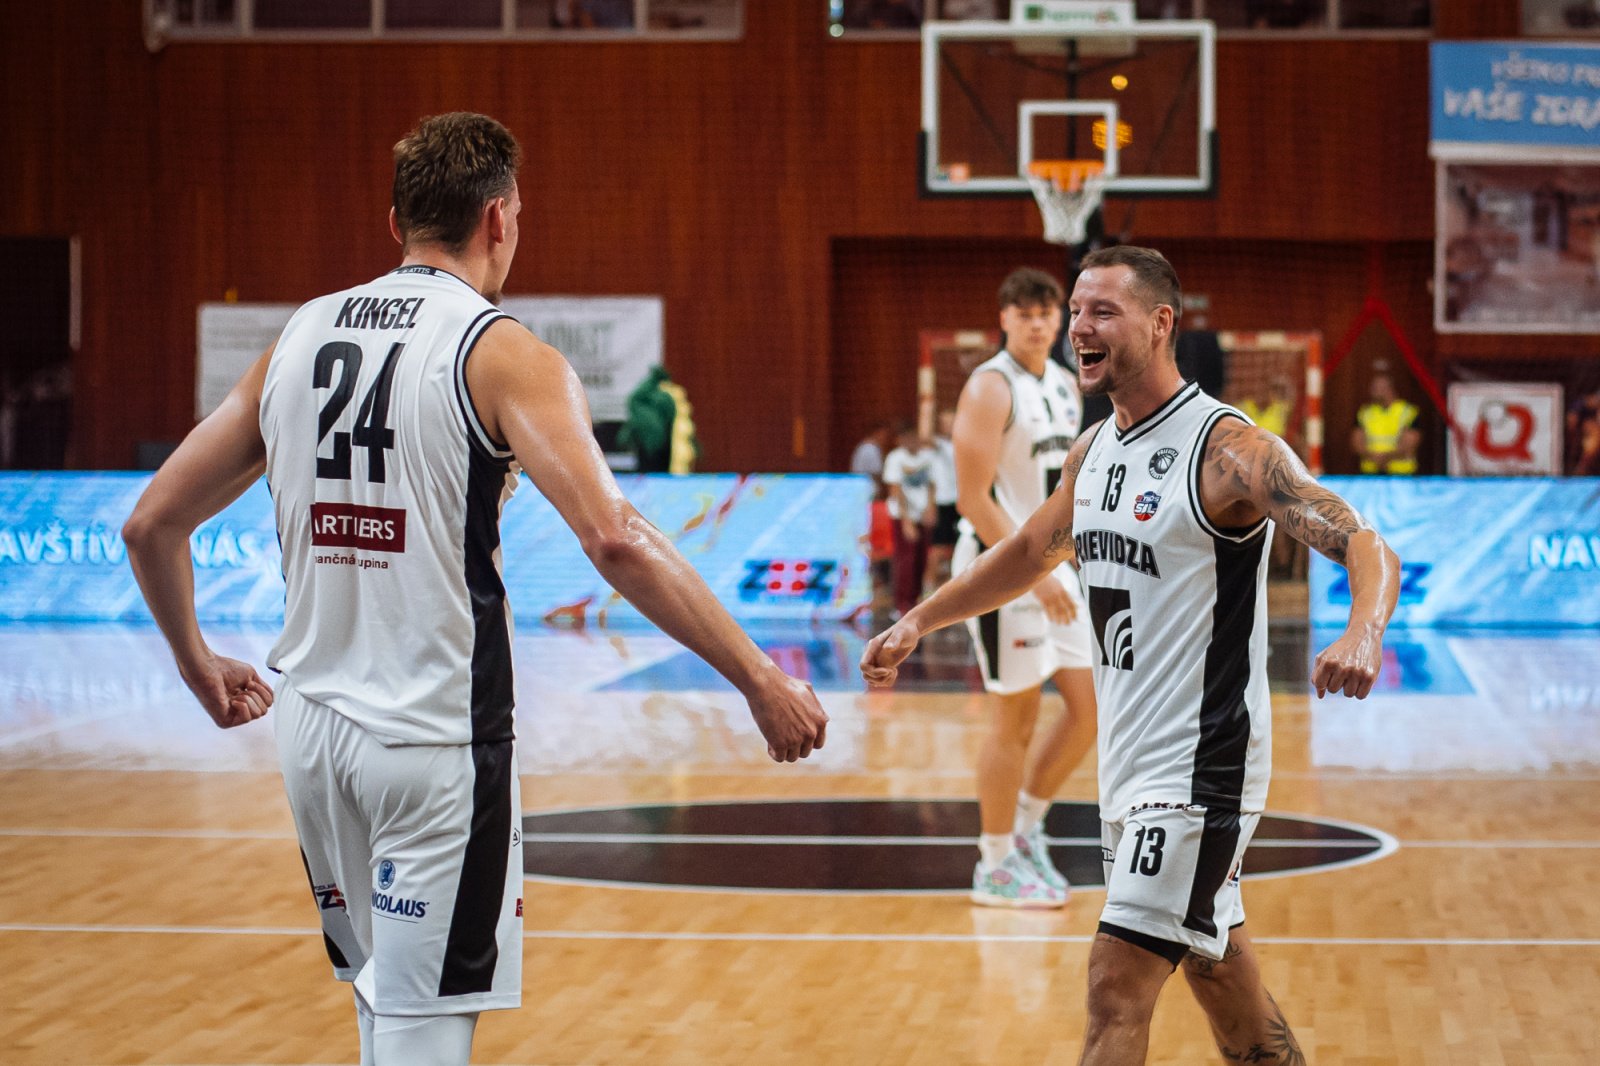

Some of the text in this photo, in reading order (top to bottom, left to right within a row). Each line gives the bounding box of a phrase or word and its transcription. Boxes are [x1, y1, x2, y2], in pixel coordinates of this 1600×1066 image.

[313, 341, 406, 484] 24
[1100, 463, 1126, 512] 13
[0, 522, 125, 565] AVŠTÍV
[1129, 826, 1166, 876] 13
